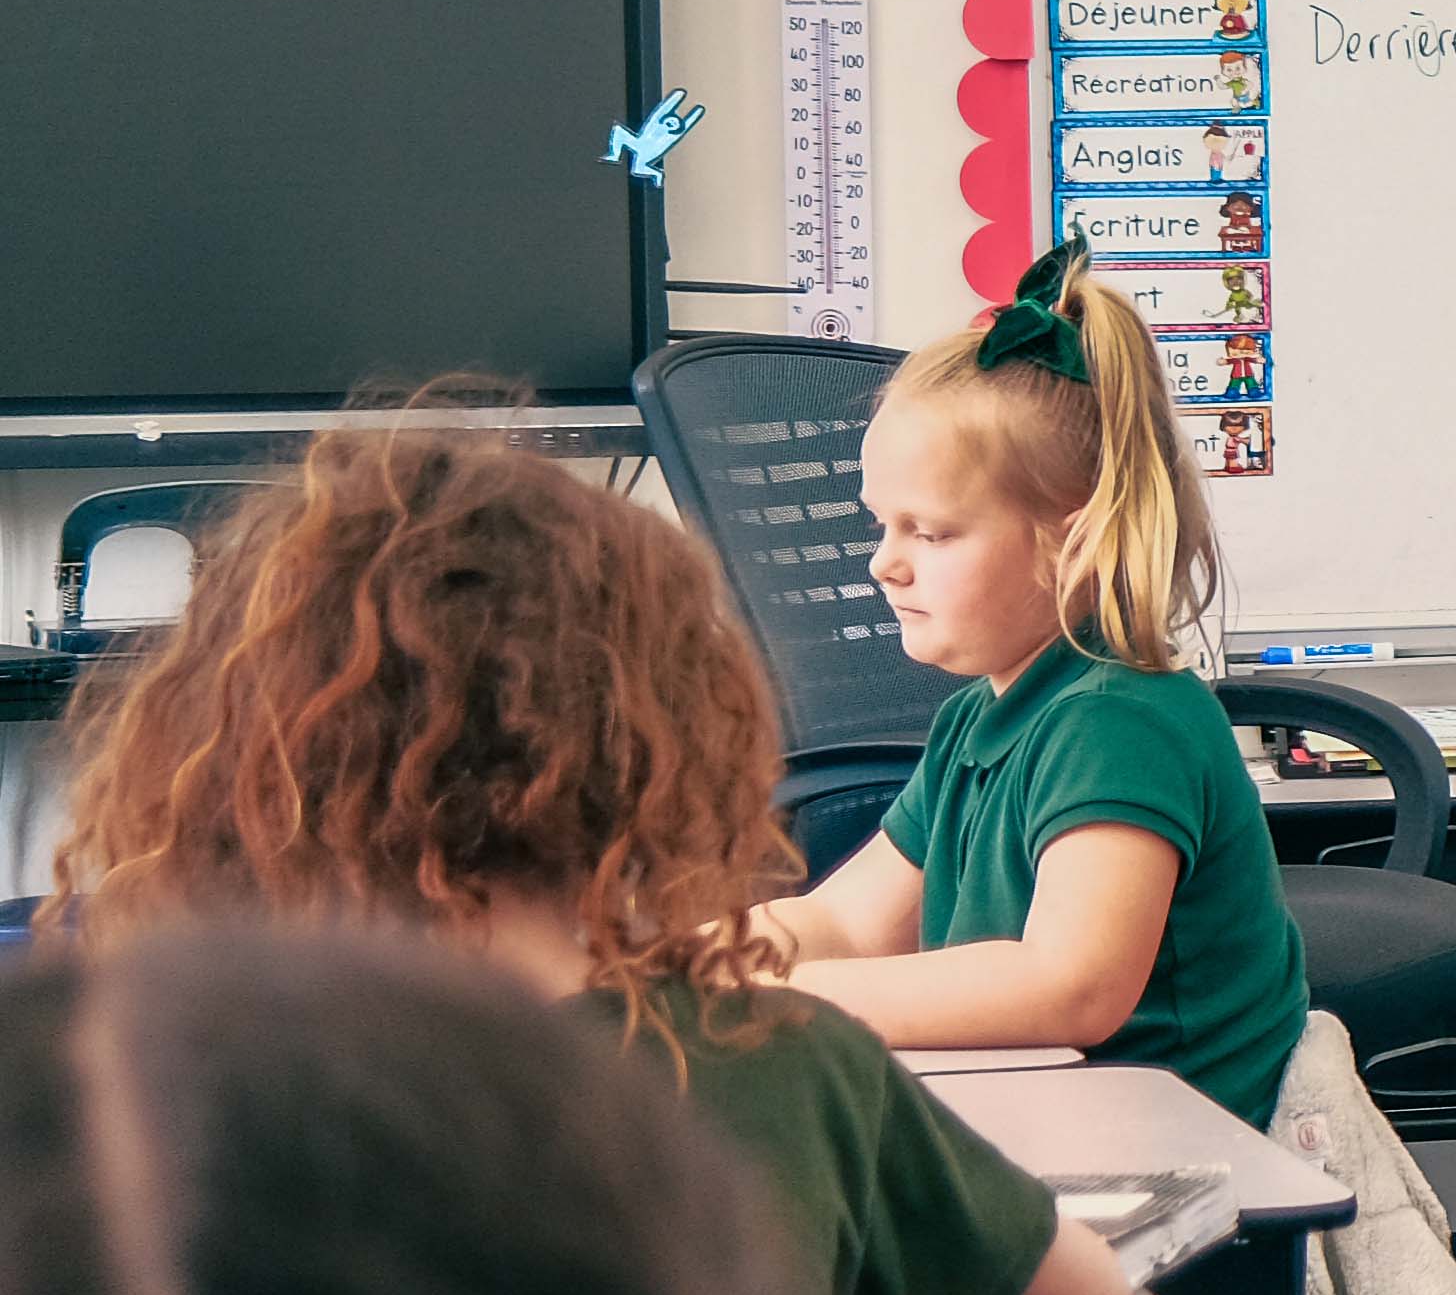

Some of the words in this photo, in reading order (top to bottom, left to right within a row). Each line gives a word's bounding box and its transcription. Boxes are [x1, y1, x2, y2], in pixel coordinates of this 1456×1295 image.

[1069, 0, 1212, 29] Déjeuner
[1072, 74, 1214, 94] Récréation
[1072, 144, 1182, 172] Anglais
